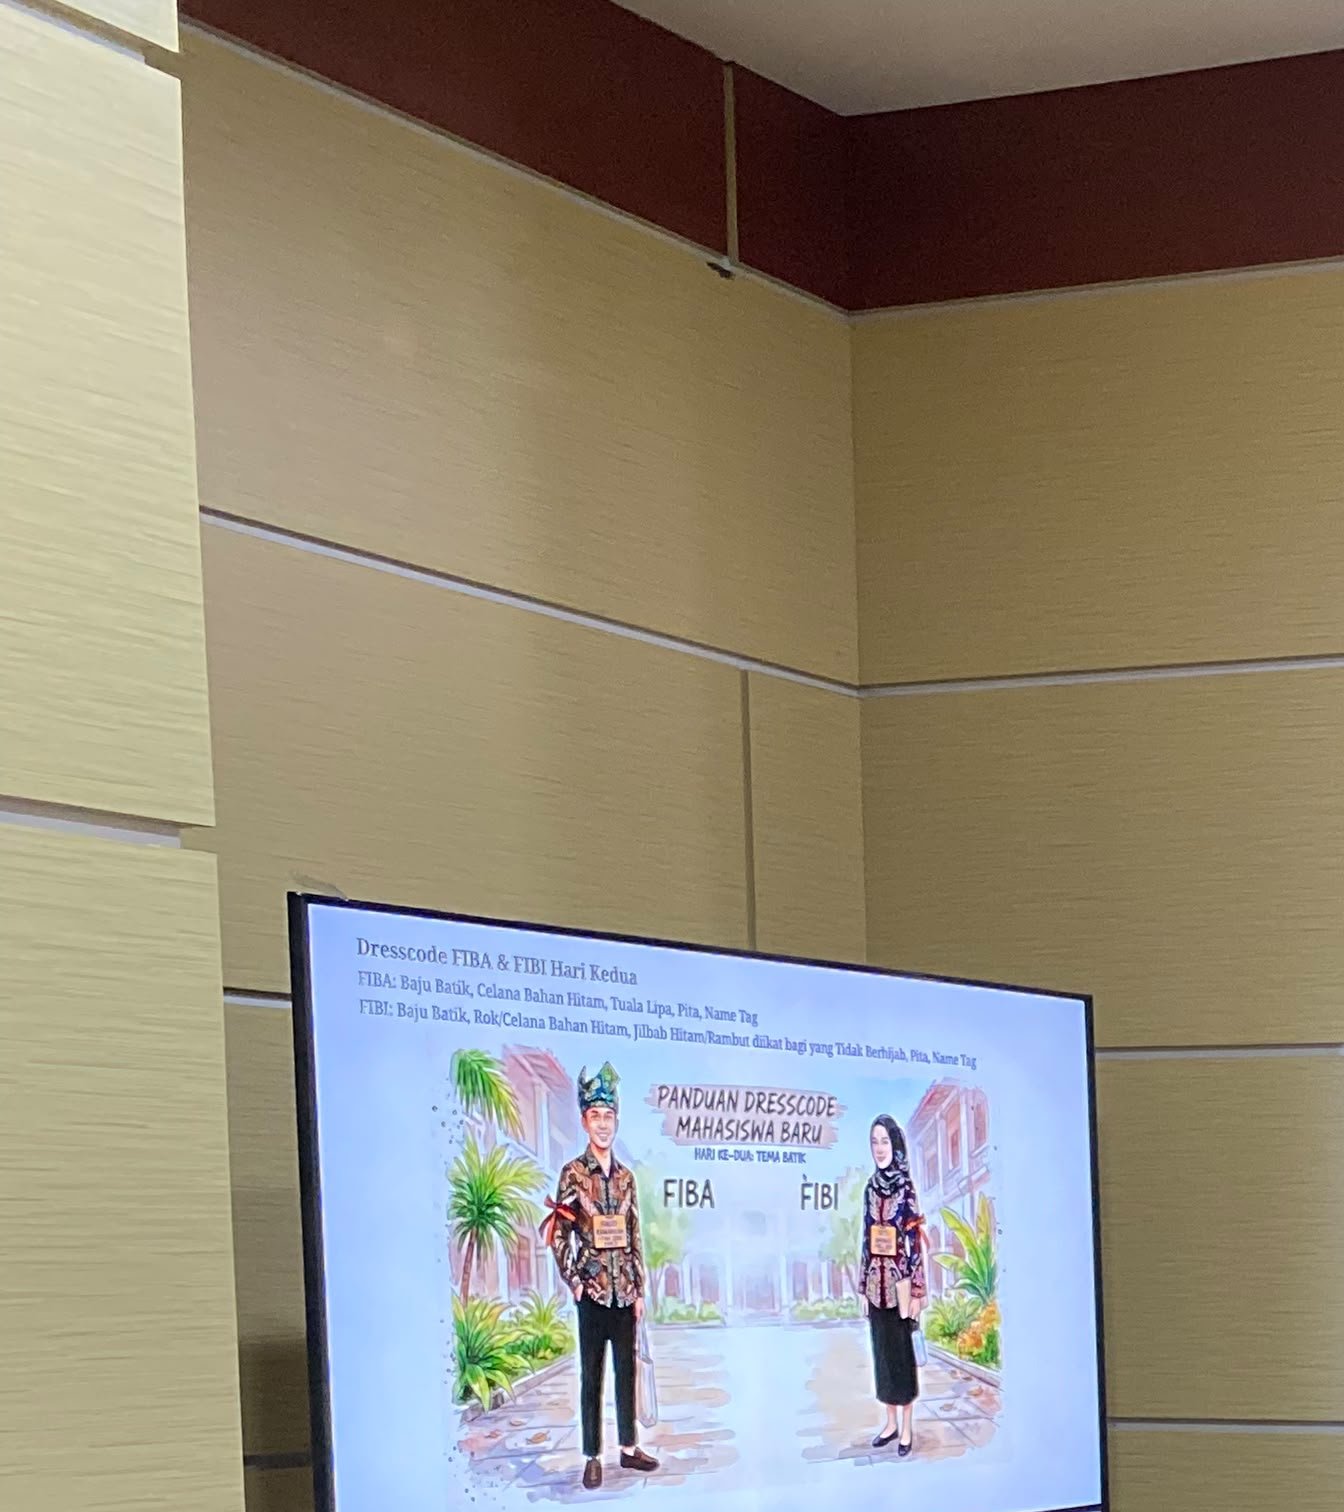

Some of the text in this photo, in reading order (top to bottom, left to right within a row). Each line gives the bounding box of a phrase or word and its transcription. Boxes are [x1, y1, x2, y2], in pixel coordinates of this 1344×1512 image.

[356, 937, 638, 986] Dresscode FIBA & FIBI Hari Kedua
[358, 971, 758, 1027] FIBA: Baju Batik, Celana Bahan Hitam, Tuala Lipa, Pita, Name Tag
[359, 999, 977, 1071] FIBI: Baju Batik, Rok/Celana Bahan Hitam, Jilbab Hitam/Rambut diikat bagi yang Tidak Berhijab, Pita, Name Tag
[657, 1085, 838, 1118] PANDUAN DRESSCODE
[676, 1116, 823, 1145] MAHASISWA BARU
[694, 1147, 807, 1164] HARI KE-DUA: TEMA BATIK
[663, 1178, 715, 1209] FIBA
[801, 1182, 839, 1211] FIBI
